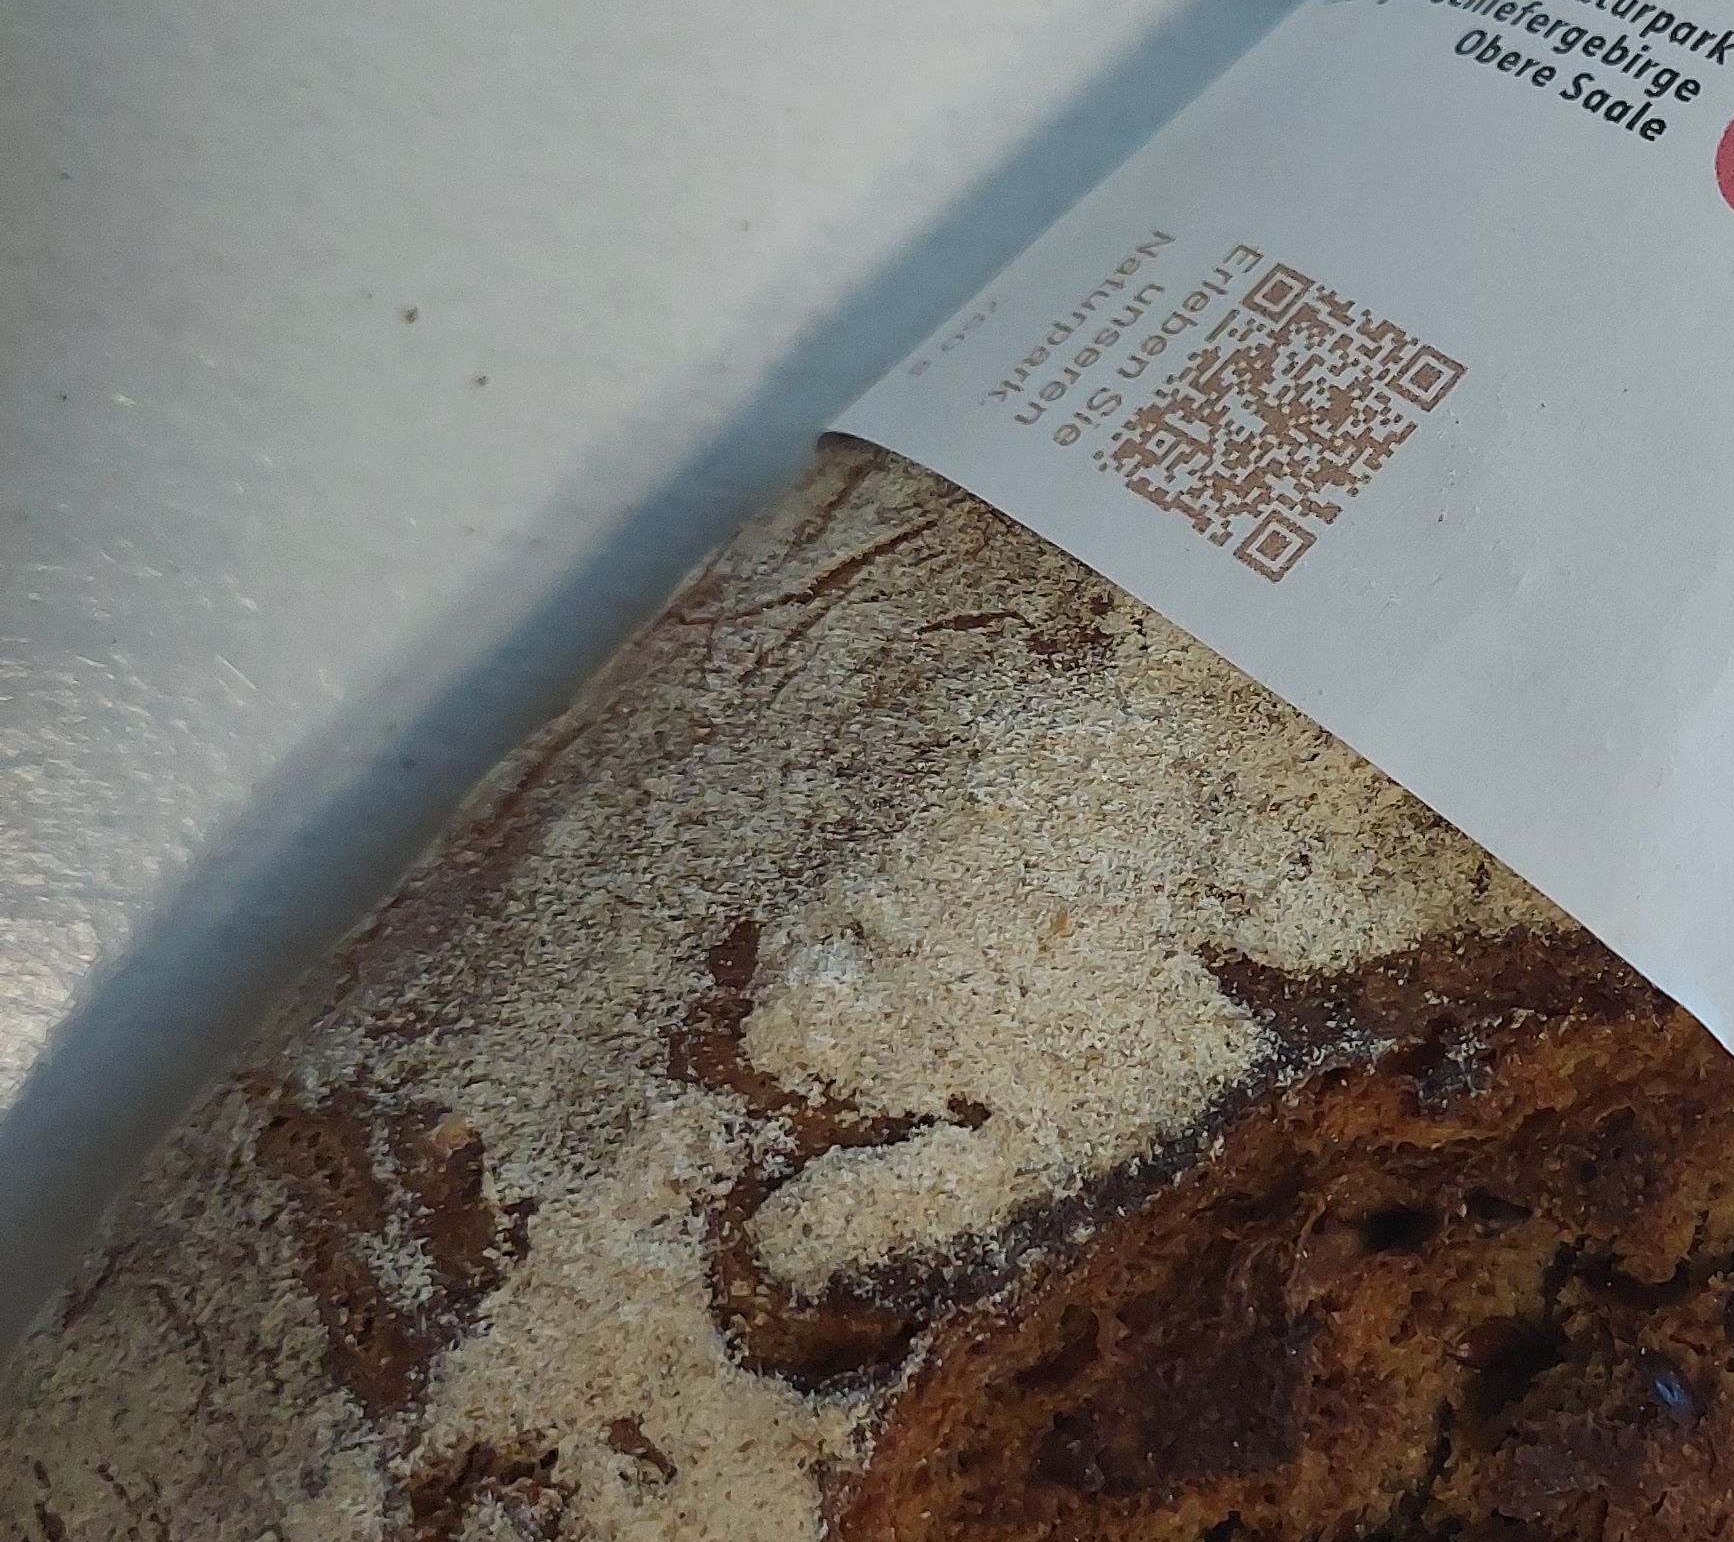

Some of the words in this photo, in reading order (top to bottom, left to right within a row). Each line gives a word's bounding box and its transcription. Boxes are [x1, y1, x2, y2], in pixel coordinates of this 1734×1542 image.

[1454, 28, 1556, 88] Obere
[1560, 72, 1668, 142] Saale
[1014, 283, 1164, 426] unseren
[1118, 244, 1264, 379] Erleben
[1053, 386, 1123, 447] Sie
